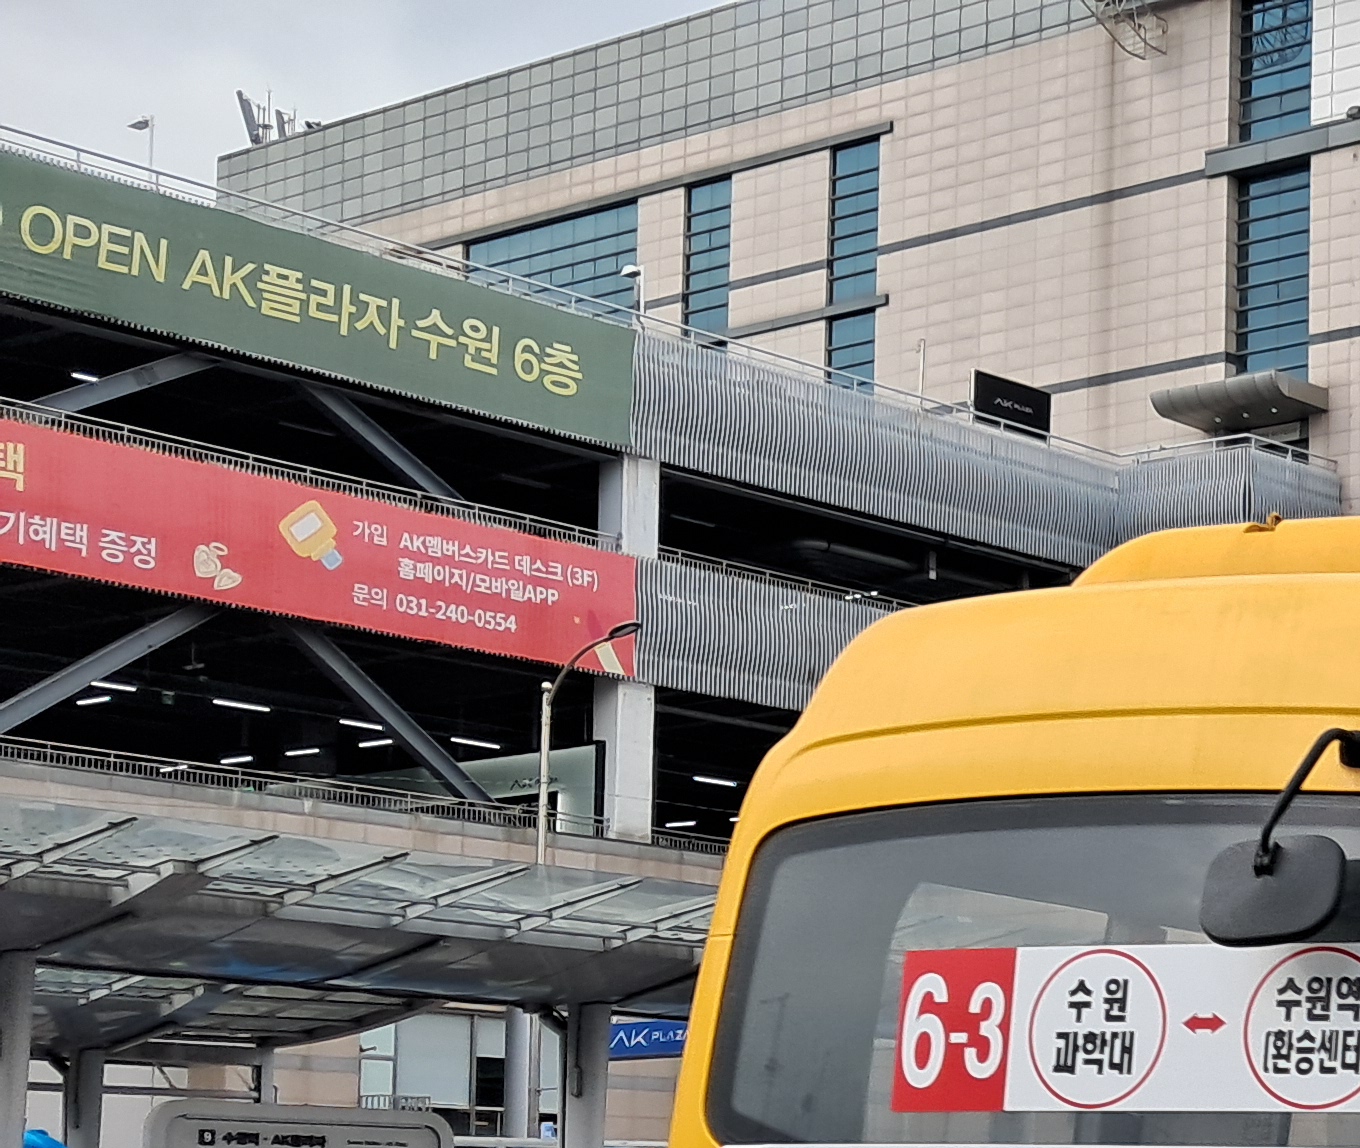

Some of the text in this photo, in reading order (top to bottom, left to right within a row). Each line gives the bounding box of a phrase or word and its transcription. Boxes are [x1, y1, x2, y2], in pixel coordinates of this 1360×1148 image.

[20, 205, 584, 397] OPEN AK플라자 수원 6층
[98, 529, 157, 570] 증정
[352, 520, 599, 592] 가입 AK멤버스카드 데스크 (3F)
[397, 557, 559, 605] 홈페이지/모바일APP
[352, 583, 518, 633] 문의 031-240-0554
[609, 1027, 650, 1049] AK
[901, 972, 1006, 1090] 6-3
[1052, 1028, 1136, 1077] 과학대
